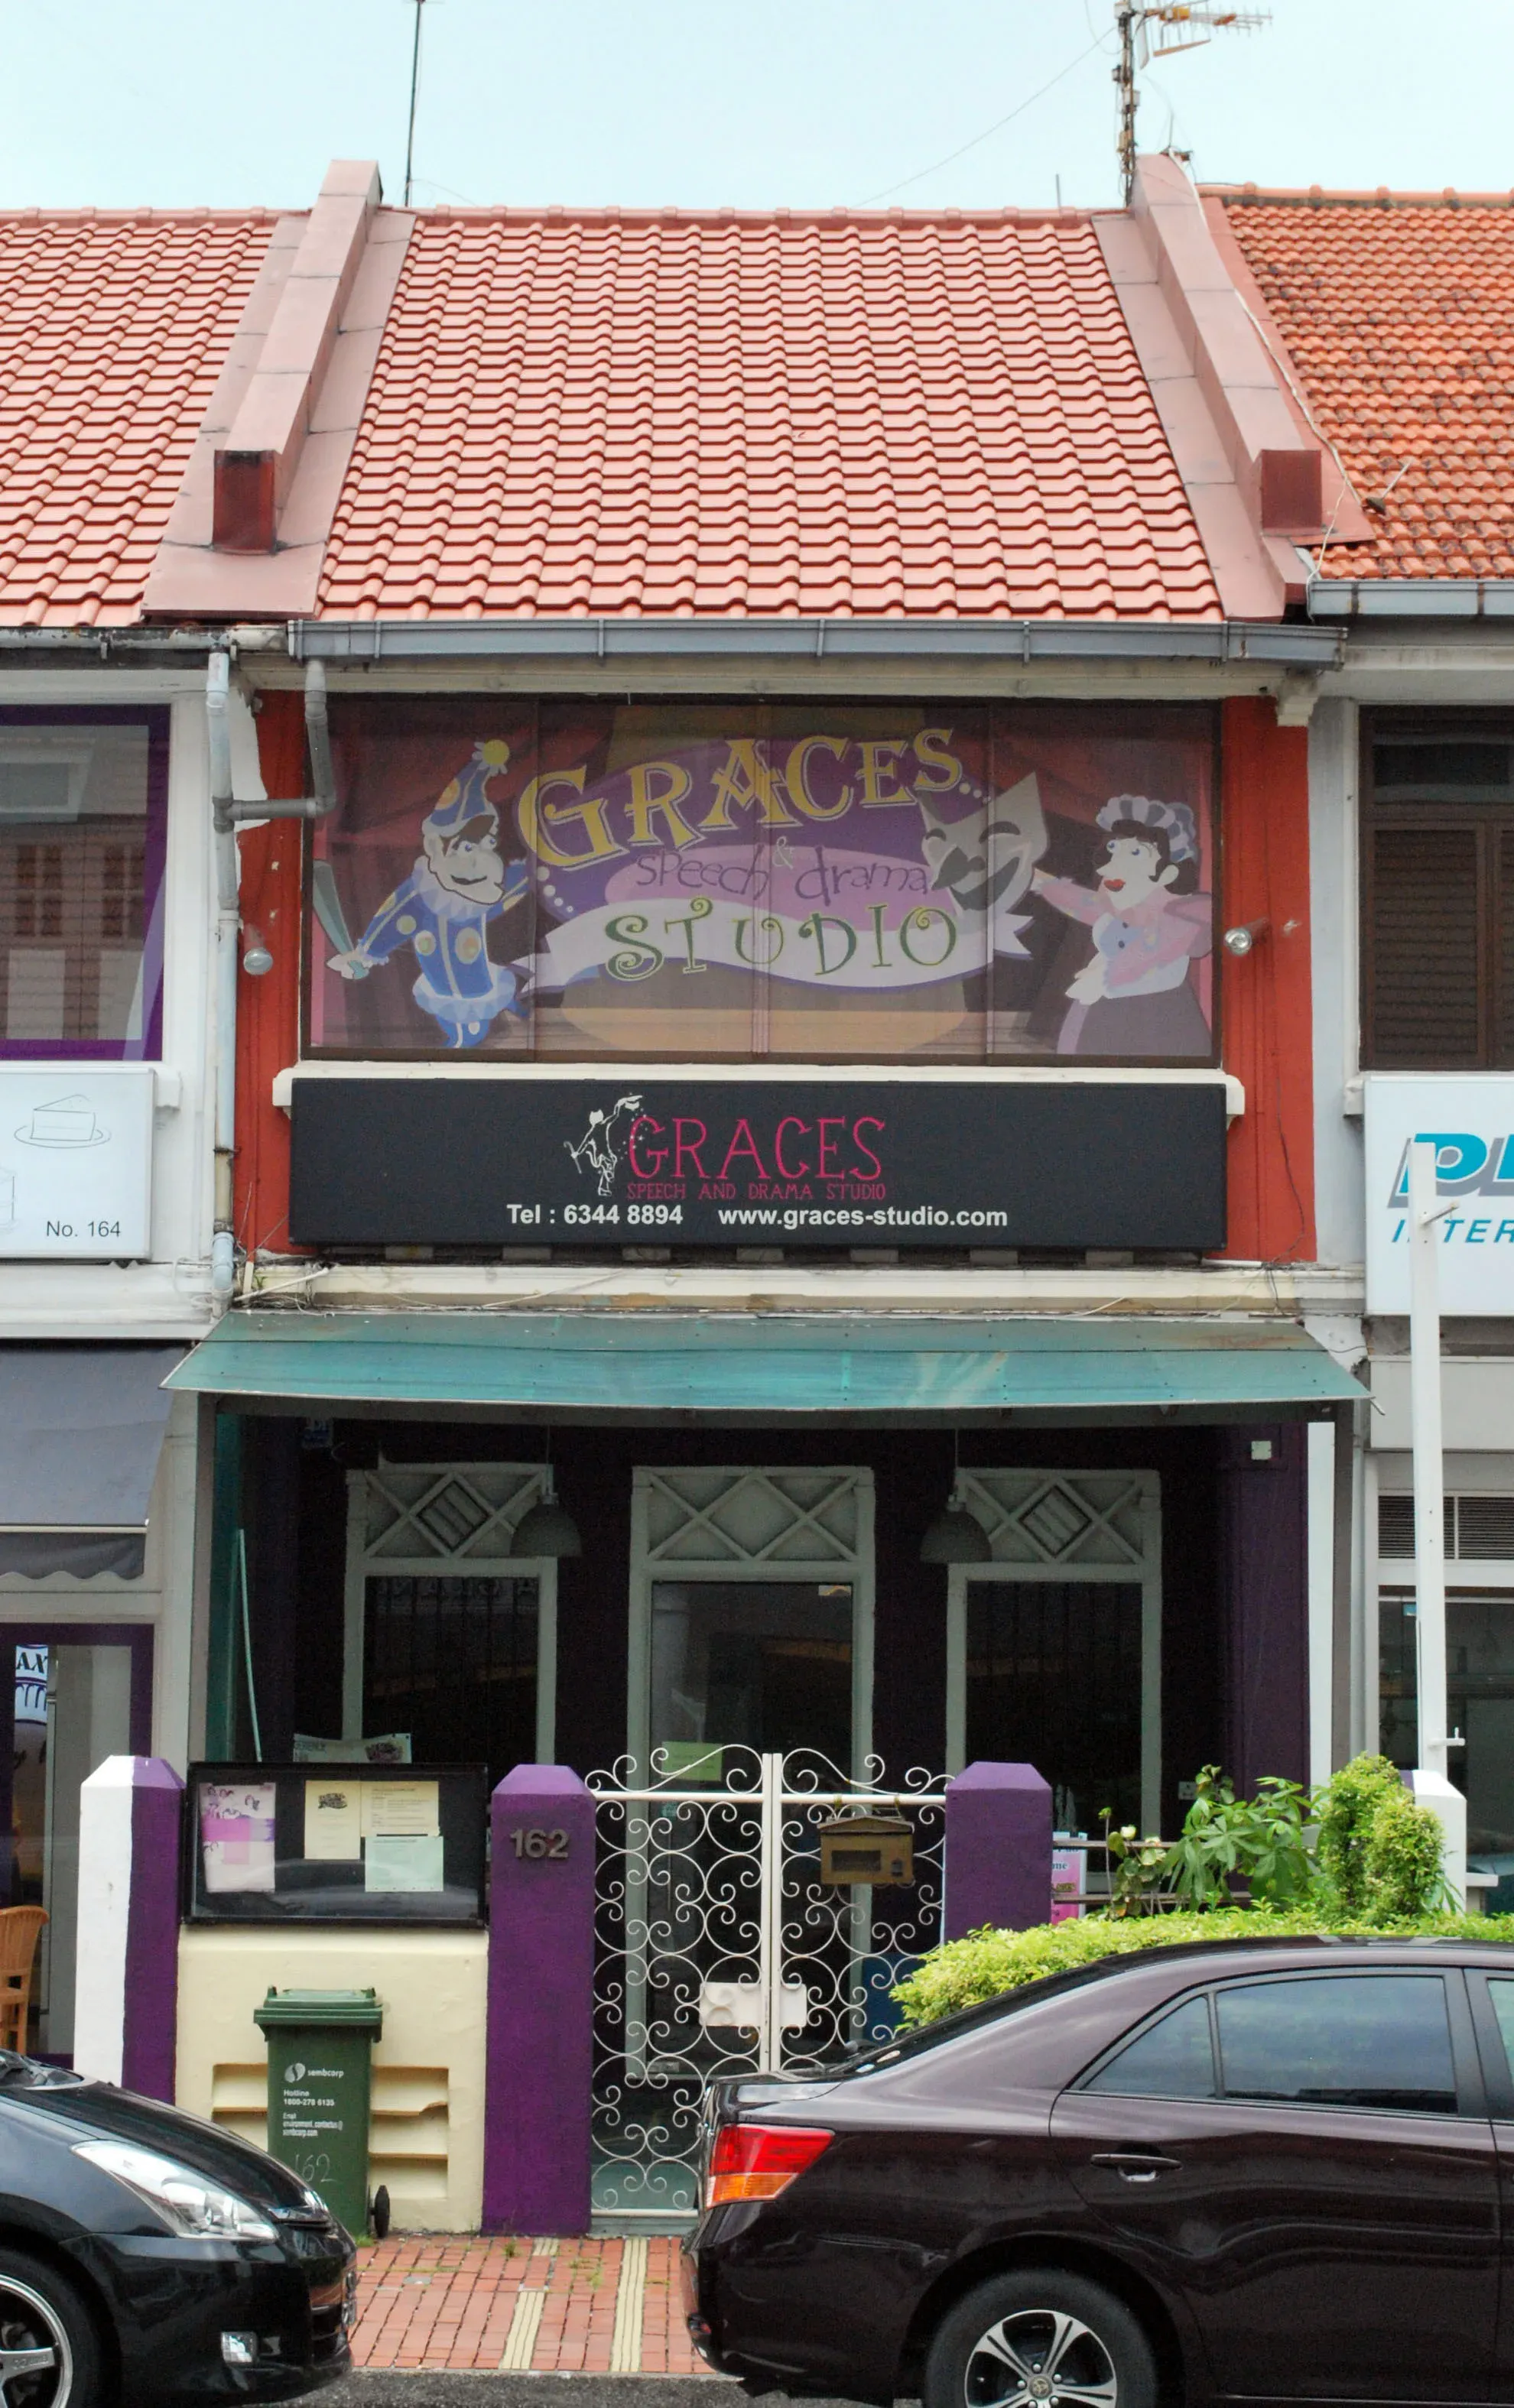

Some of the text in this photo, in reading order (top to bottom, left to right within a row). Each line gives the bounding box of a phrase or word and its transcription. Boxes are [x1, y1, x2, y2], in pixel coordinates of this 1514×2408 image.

[518, 728, 962, 872] GRACES
[772, 836, 795, 869] &
[794, 845, 928, 906] drama
[604, 897, 957, 981] STUDIO
[629, 1116, 885, 1180] GRACES
[627, 1183, 885, 1200] SPEECH AND DRAMA STUDIO
[46, 1221, 121, 1238] No. 164
[506, 1204, 541, 1224] Tel
[564, 1204, 619, 1224] 6344
[627, 1204, 683, 1225] 8894
[718, 1206, 1008, 1230] www.graces-studio.com
[509, 1829, 569, 1858] 162
[307, 2068, 344, 2079] sembcorp
[294, 2153, 337, 2182] 162
